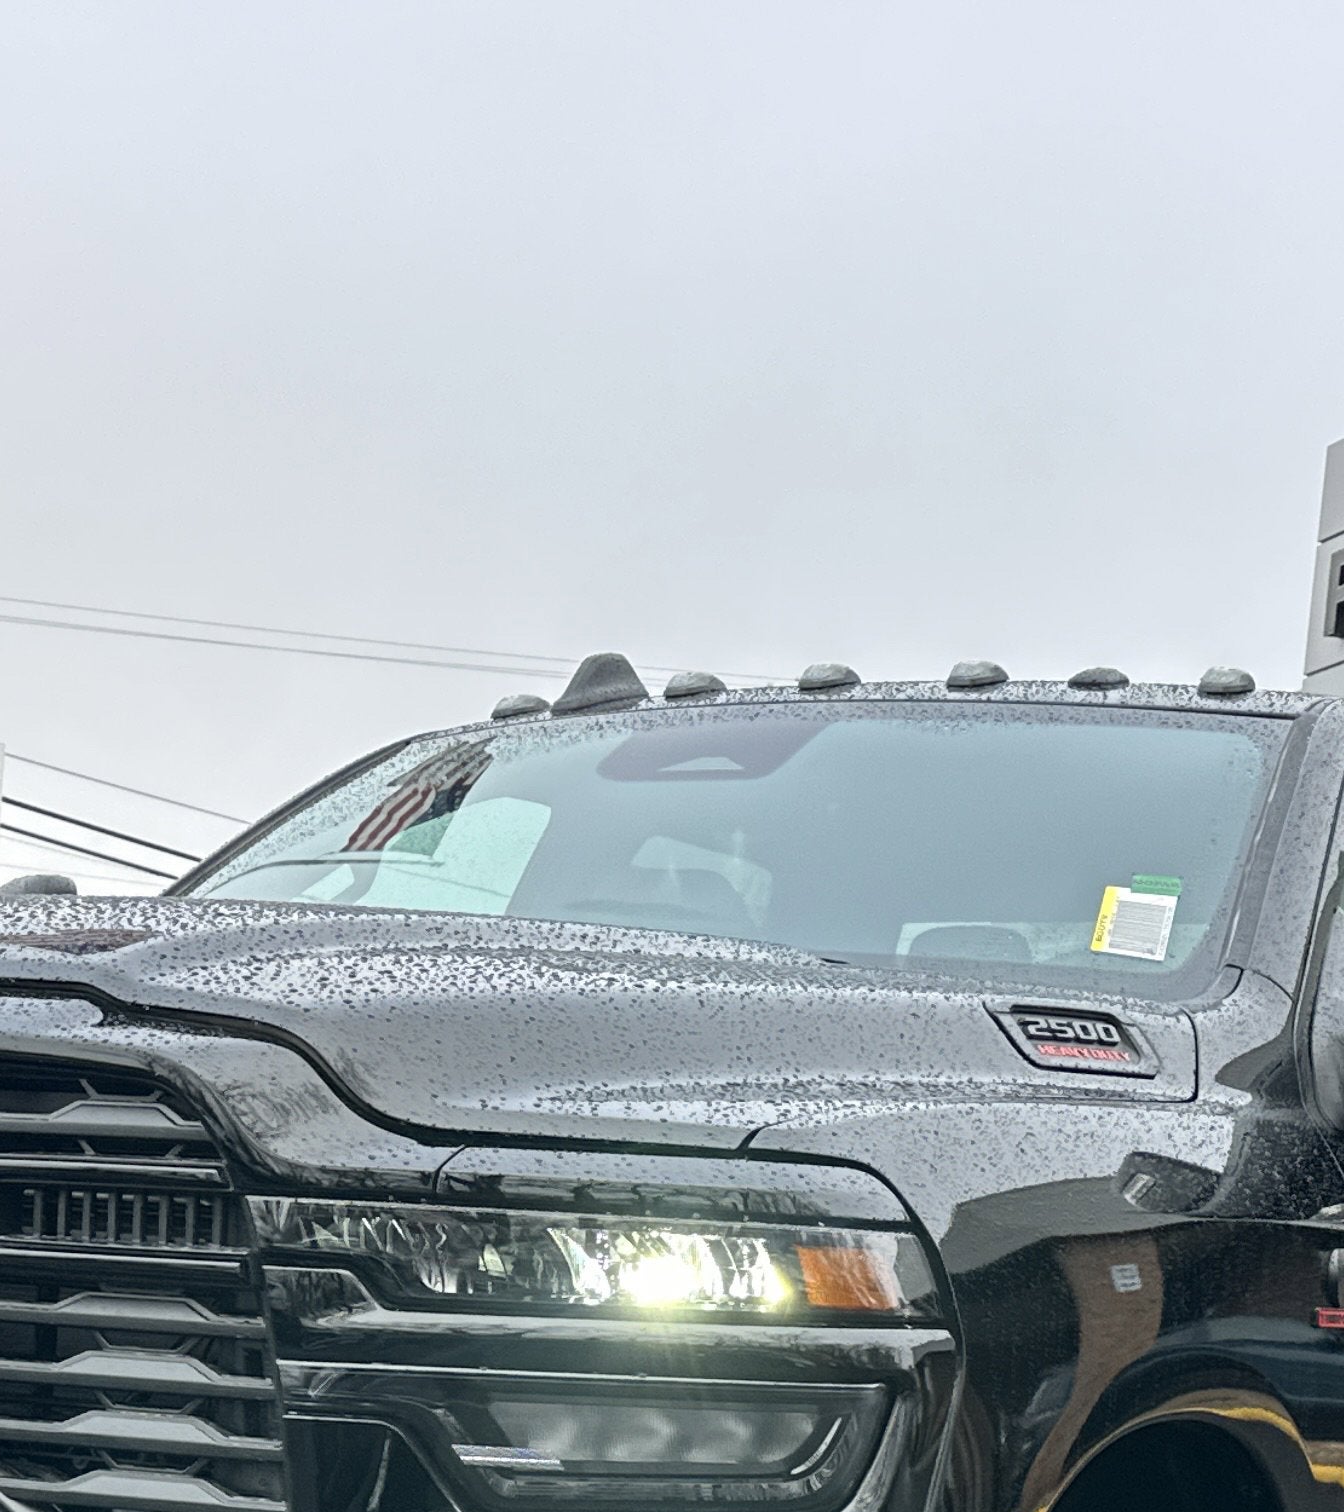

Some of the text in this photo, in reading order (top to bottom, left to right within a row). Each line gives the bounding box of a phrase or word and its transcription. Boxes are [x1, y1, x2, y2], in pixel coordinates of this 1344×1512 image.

[1021, 1017, 1120, 1045] 2500
[1038, 1044, 1130, 1061] HEAVY DUTY
